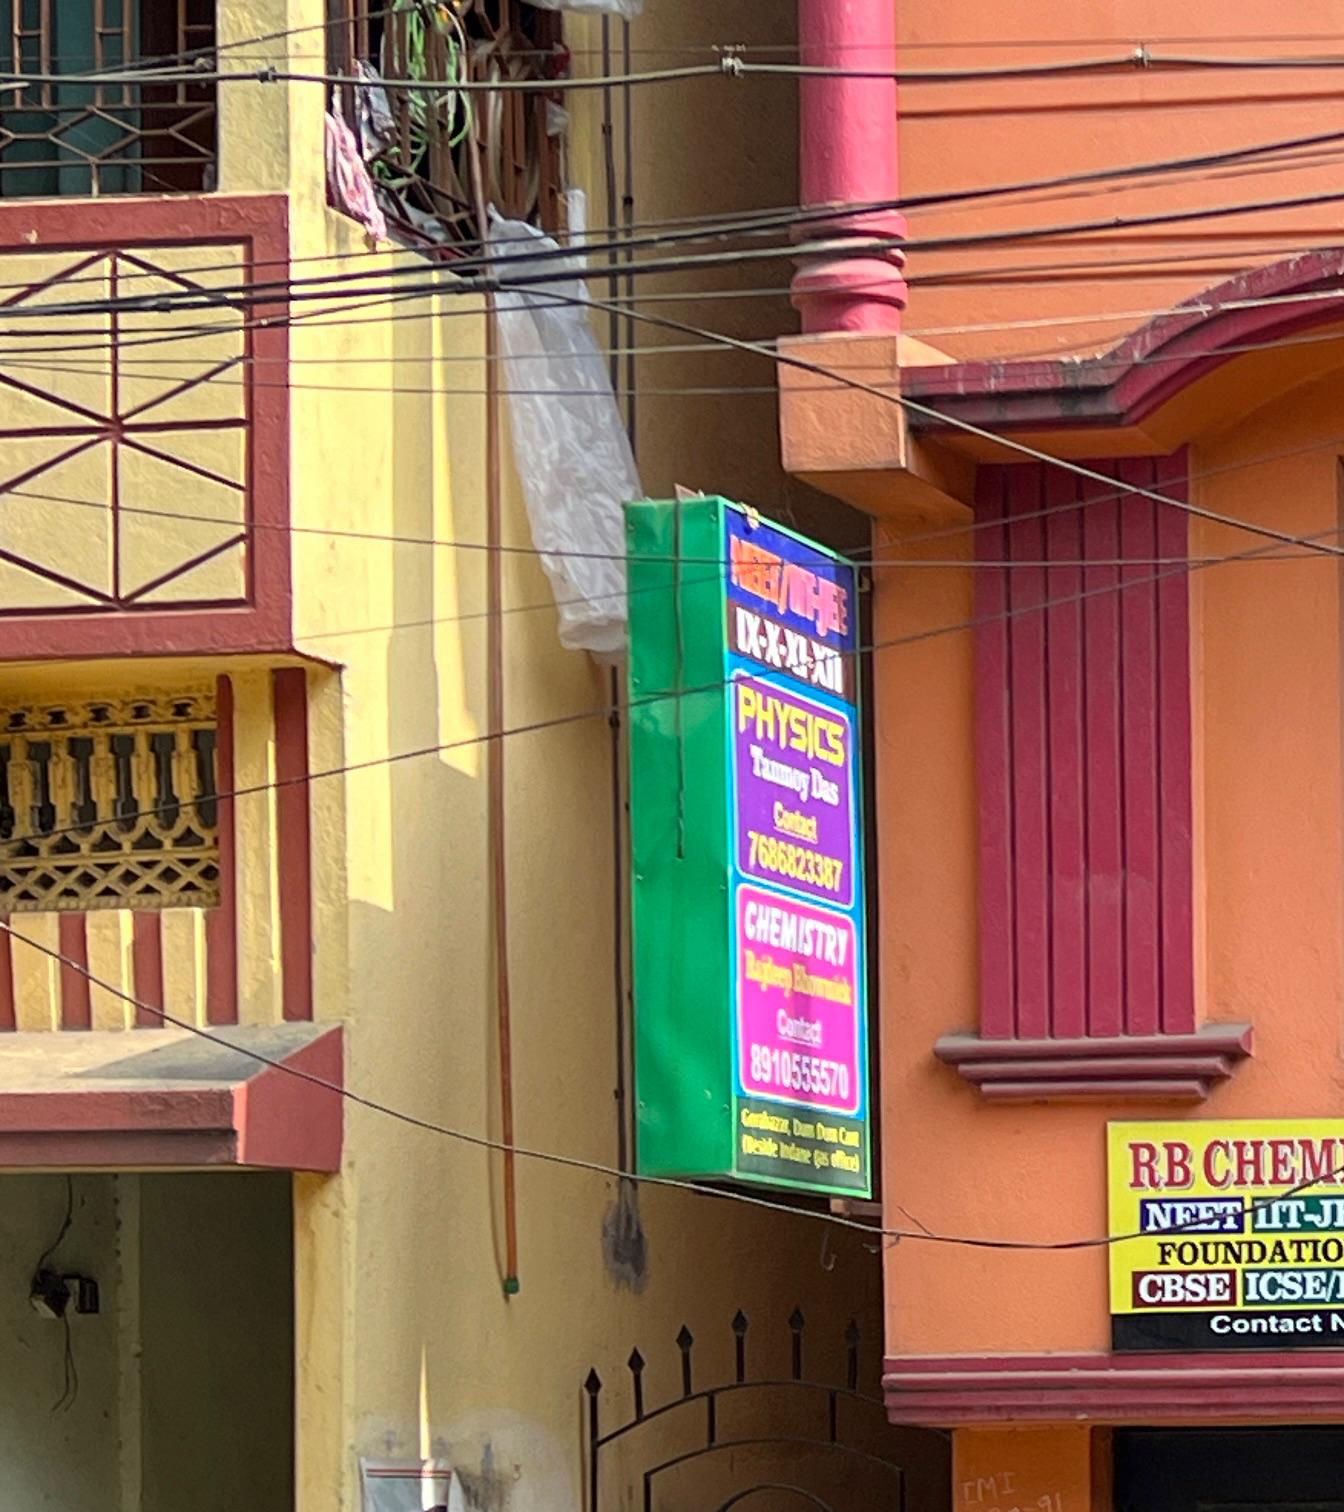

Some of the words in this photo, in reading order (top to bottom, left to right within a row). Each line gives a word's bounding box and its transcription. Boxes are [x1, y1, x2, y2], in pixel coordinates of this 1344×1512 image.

[735, 606, 843, 694] IX-X-XI-XII
[737, 685, 845, 767] PHYSICS
[810, 767, 839, 806] Das
[773, 801, 817, 838] Contact
[748, 831, 843, 891] 7686823387
[744, 901, 849, 967] CHEMISTRY
[777, 1009, 822, 1044] Contact
[751, 1044, 849, 1100] 8910555570
[1128, 1141, 1192, 1188] RB
[1145, 1201, 1241, 1232] NEET
[1139, 1273, 1232, 1304] CBSE
[1210, 1314, 1323, 1334] Contact
